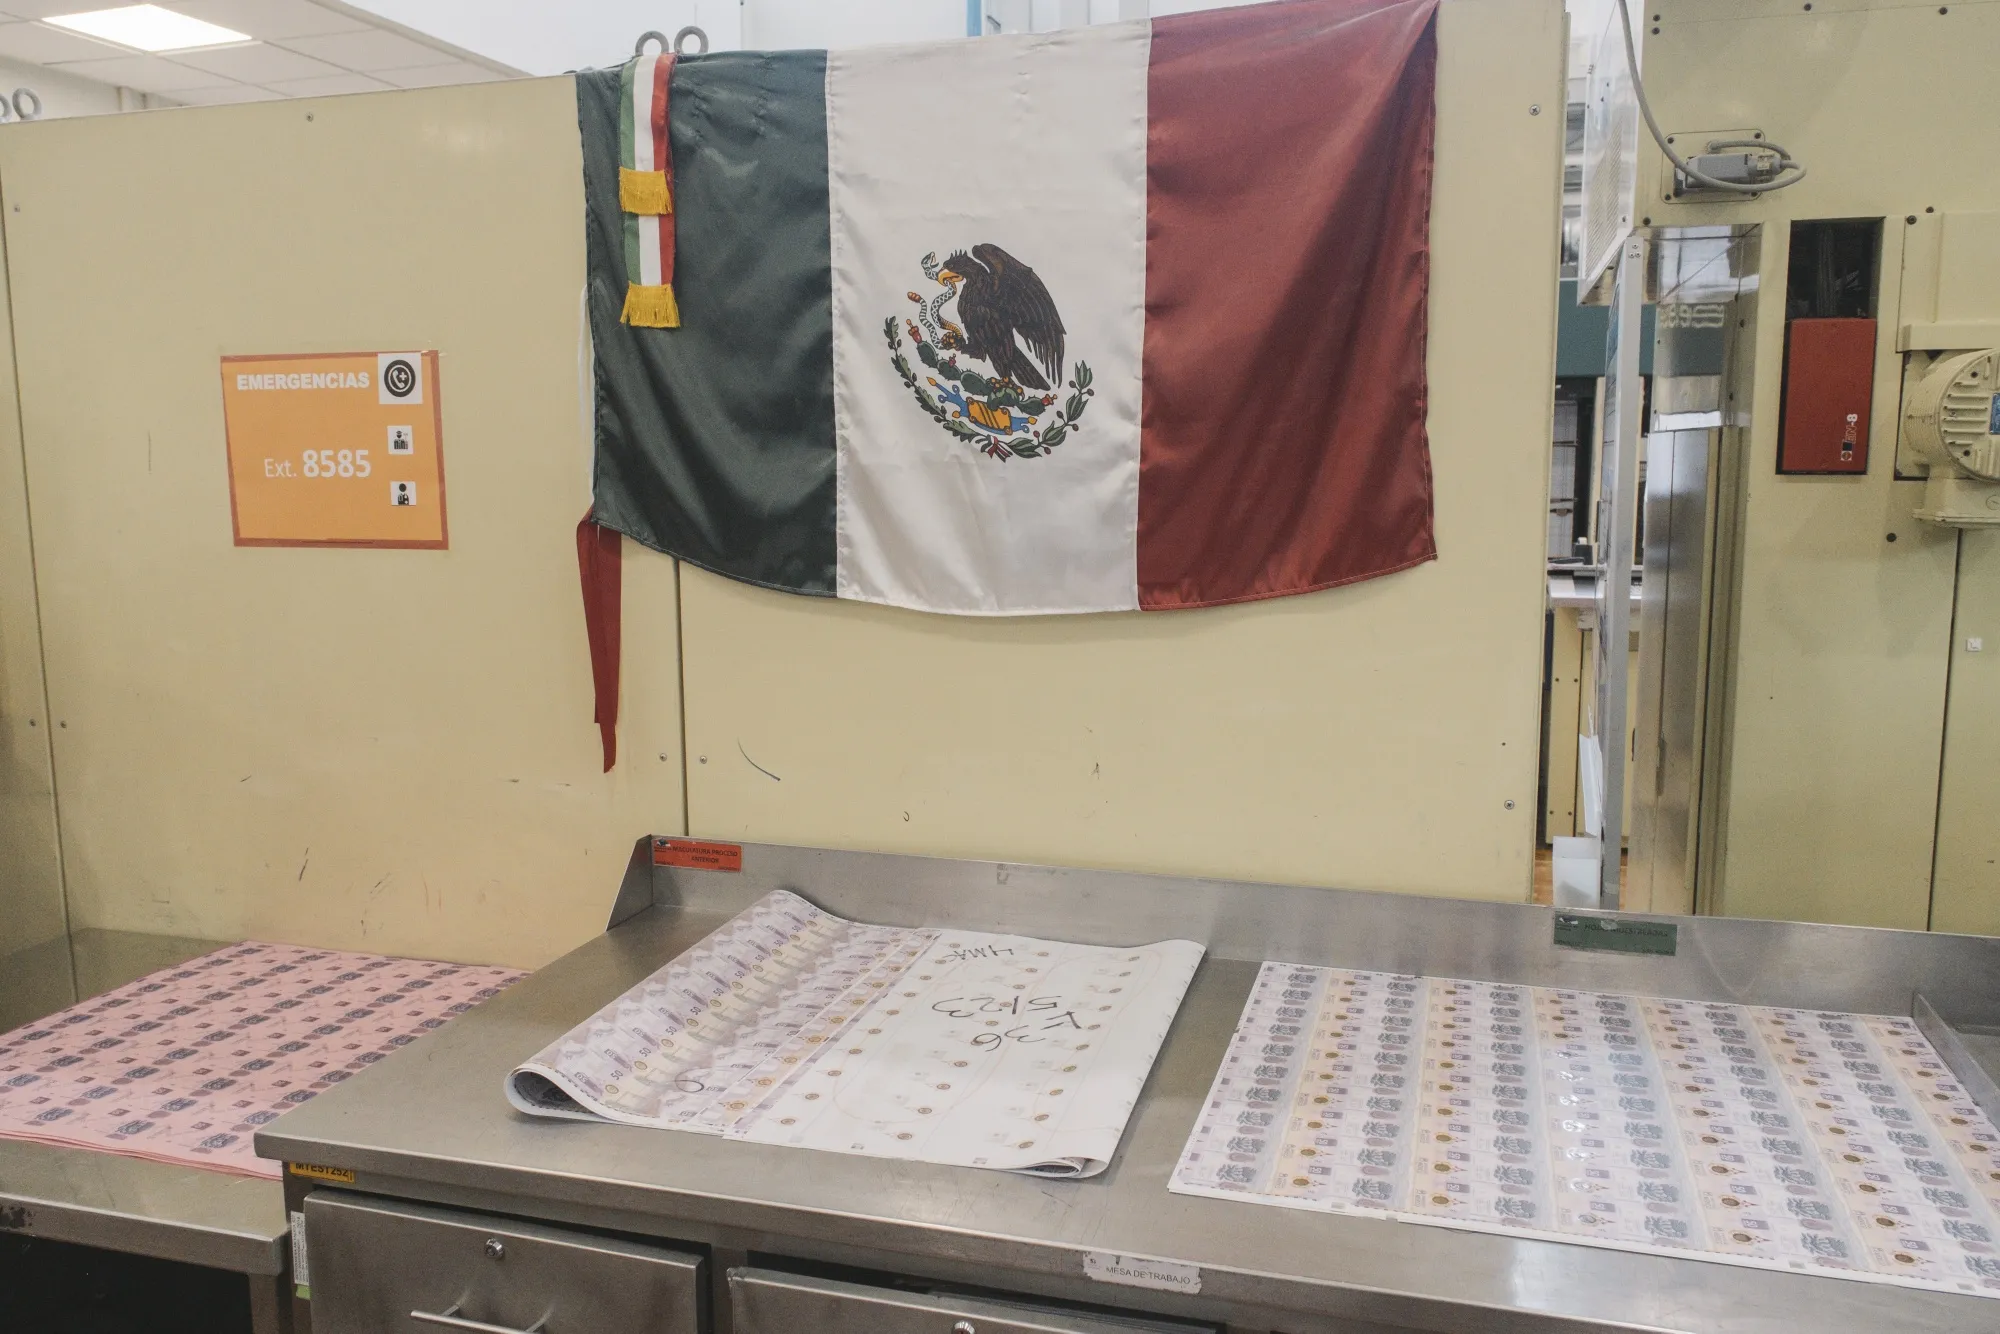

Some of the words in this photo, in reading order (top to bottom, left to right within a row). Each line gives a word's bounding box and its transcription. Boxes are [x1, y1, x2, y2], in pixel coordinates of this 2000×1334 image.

[236, 372, 370, 391] EMERGENCIAS
[264, 458, 297, 478] Ext.
[302, 449, 371, 478] 8585
[1105, 1266, 1132, 1277] MESA
[1133, 1269, 1146, 1279] DE
[1147, 1271, 1191, 1285] TRABAJO
